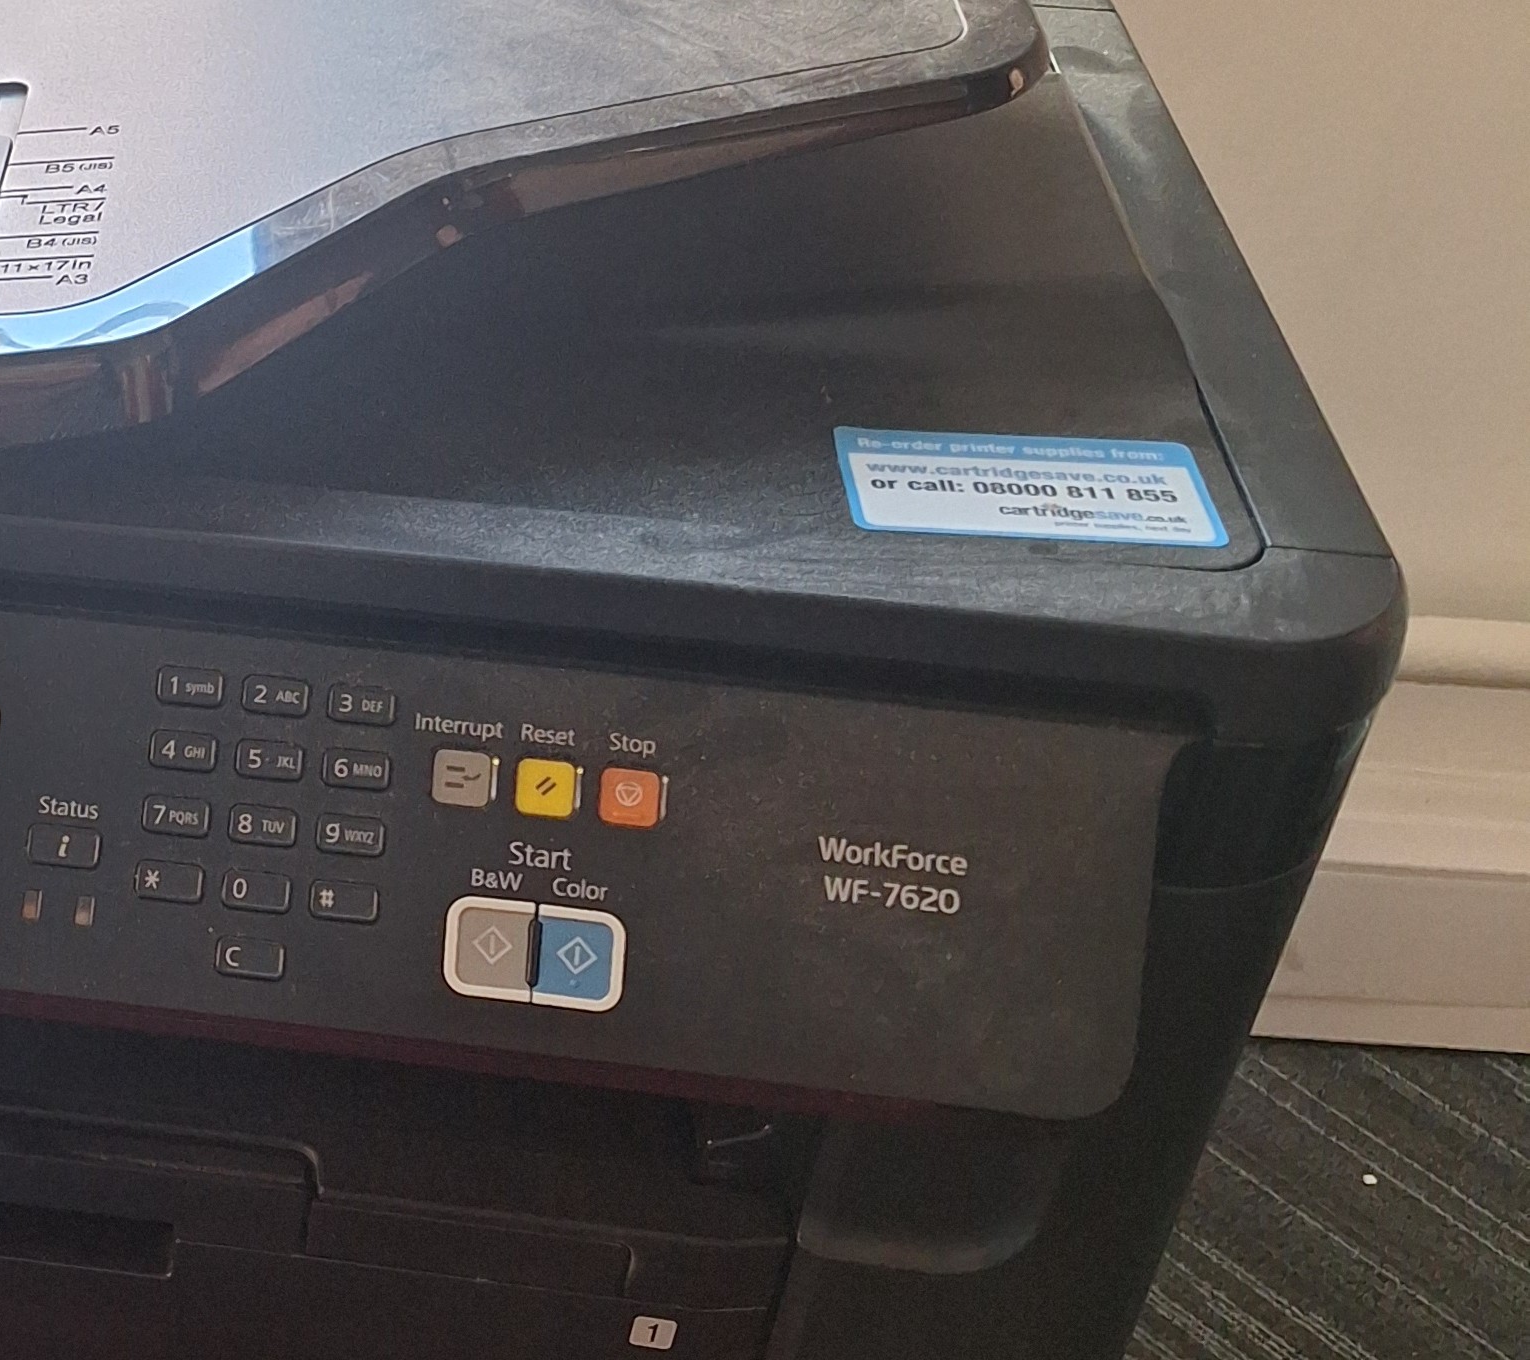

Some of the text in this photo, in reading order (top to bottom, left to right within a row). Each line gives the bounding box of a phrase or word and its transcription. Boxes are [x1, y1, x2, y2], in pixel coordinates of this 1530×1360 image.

[88, 125, 120, 136] A5
[45, 161, 113, 174] B5 (JIS)
[74, 183, 107, 195] A4
[38, 212, 102, 226] Legal
[26, 236, 97, 249] B4 (JIS)
[56, 274, 89, 286] A3
[857, 436, 1165, 461] Re-order printer supplies from:
[866, 462, 1167, 486] www.cartridgesave.co.uk
[871, 478, 1178, 503] or call: 08000 811 855
[998, 503, 1188, 524] cartridgesave.co.uk
[170, 675, 215, 696] 1 symb
[253, 685, 301, 705] 2 ABC
[338, 693, 384, 714] 3 DEF
[414, 712, 504, 741] Interrupt
[520, 723, 576, 747] Reset
[161, 740, 206, 760] 4 GHI
[609, 732, 656, 758] Stop
[247, 748, 296, 770] 5 JKL
[333, 758, 382, 778] 6 MNO
[38, 795, 99, 820] Status
[152, 804, 199, 826] 7 PQRS
[237, 813, 286, 834] 8 TUV
[325, 822, 374, 845] 9 WXYZ
[508, 841, 572, 871] Start
[818, 835, 970, 878] WorkForce
[232, 877, 248, 899] 0
[471, 868, 523, 891] B&W
[552, 876, 609, 901] Color
[824, 875, 961, 916] WF-7620
[225, 945, 241, 967] C
[647, 1323, 660, 1343] 1
